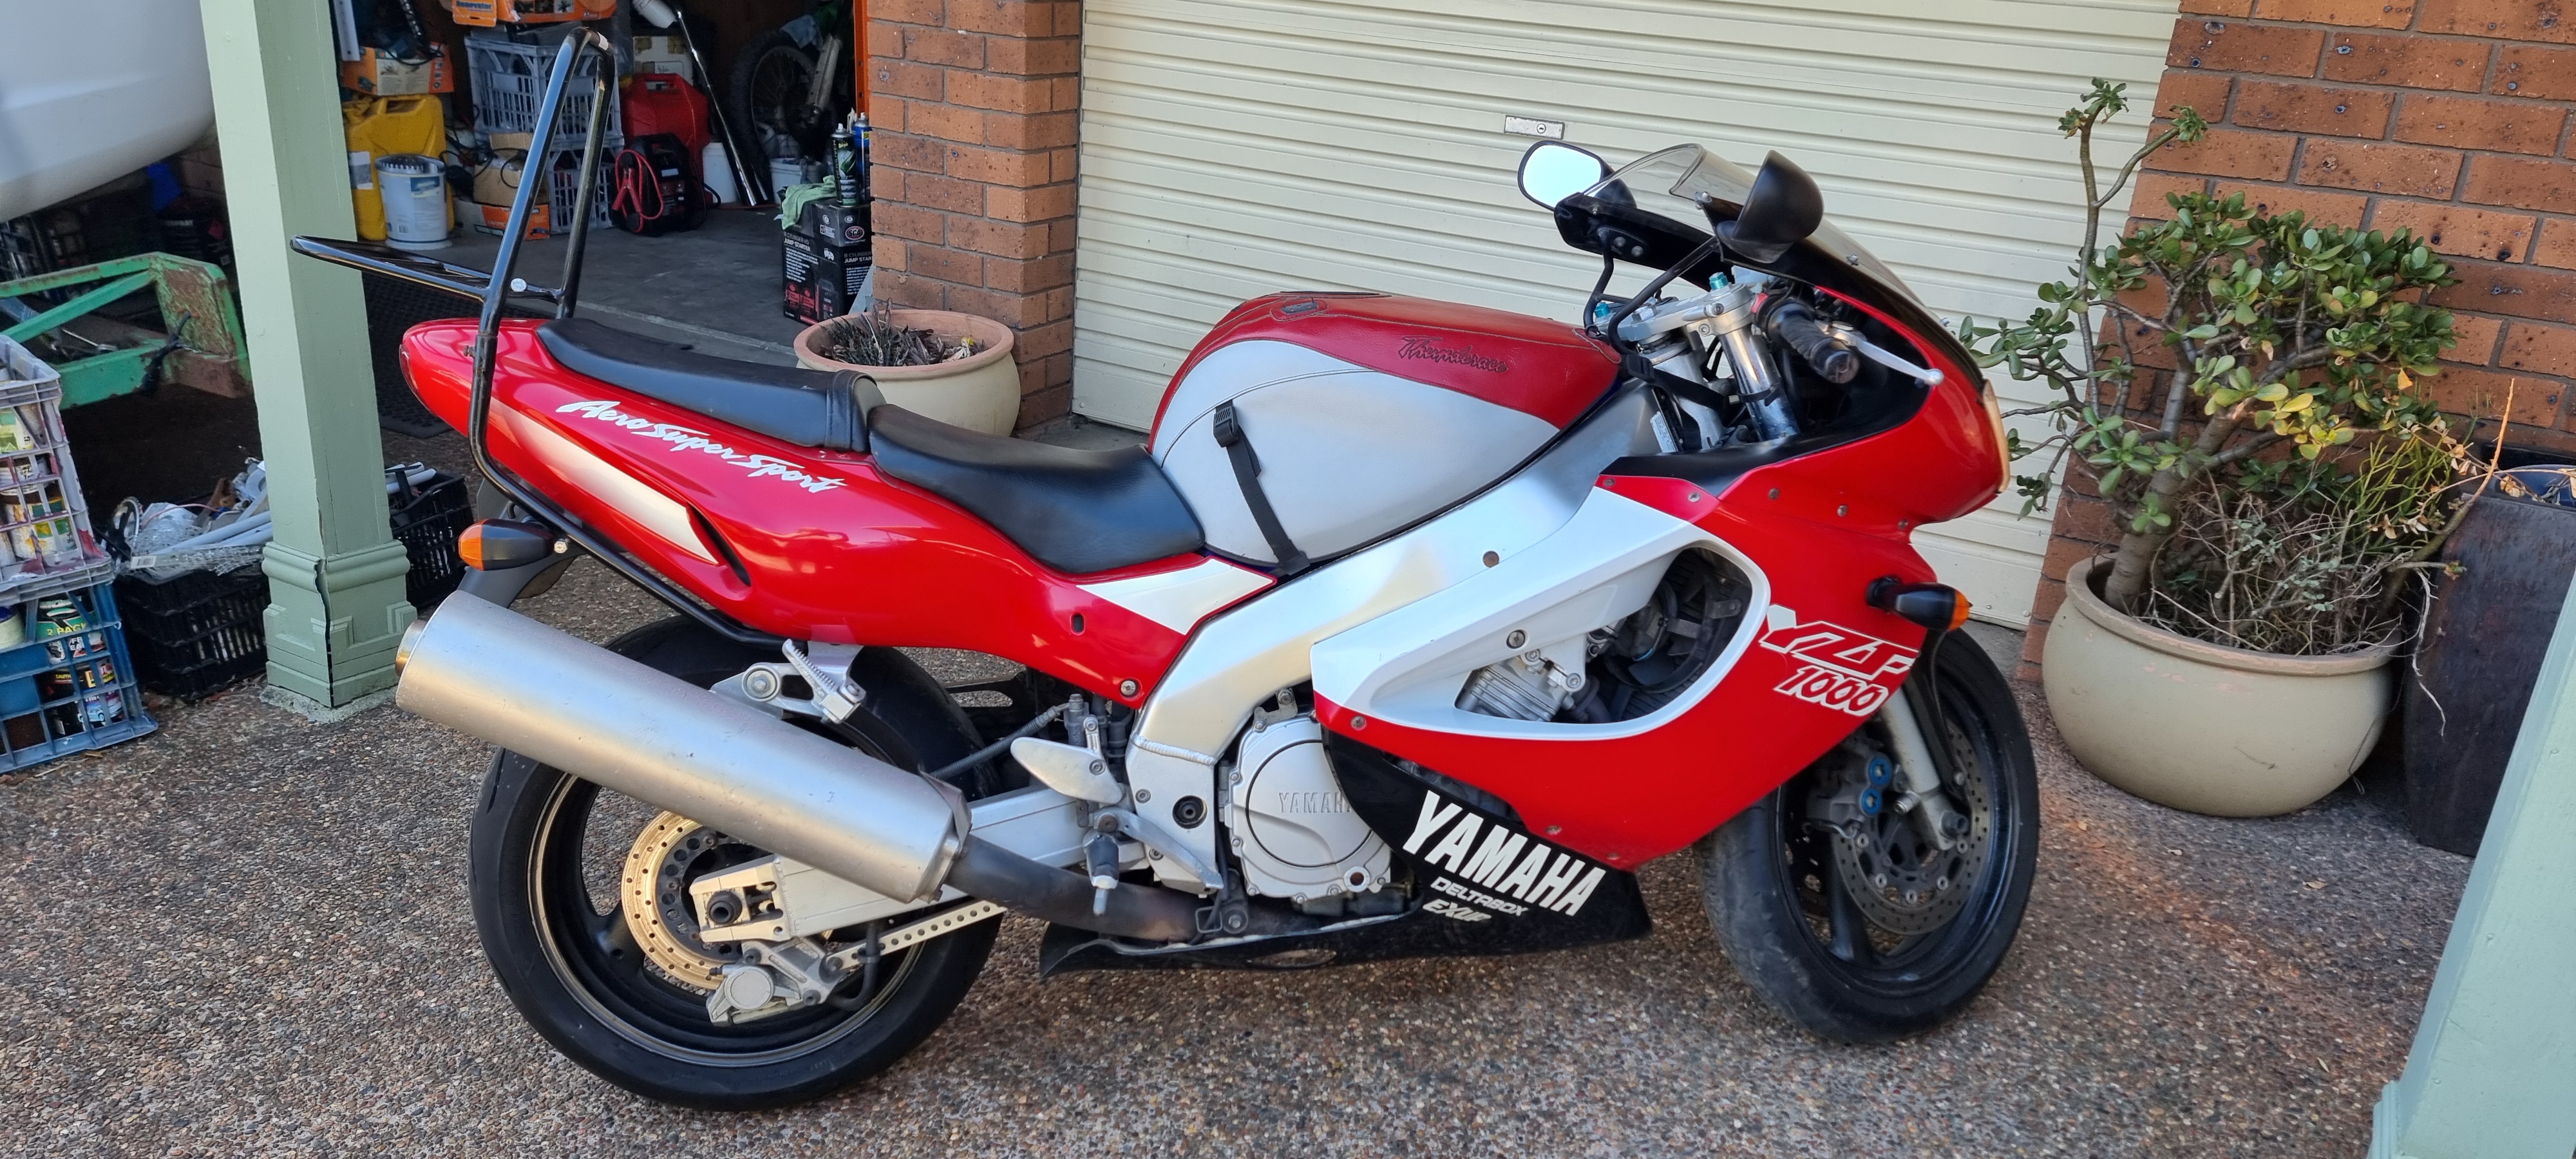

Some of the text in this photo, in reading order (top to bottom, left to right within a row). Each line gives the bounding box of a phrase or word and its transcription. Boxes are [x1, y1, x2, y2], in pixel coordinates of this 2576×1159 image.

[848, 228, 861, 236] SCA
[1758, 603, 1920, 681] YZF
[1772, 664, 1889, 717] 1000
[1278, 792, 1352, 813] YAMAH
[1402, 789, 1607, 916] YAMAHA
[1422, 898, 1492, 922] EXUP
[1430, 876, 1529, 916] DELTABOX
